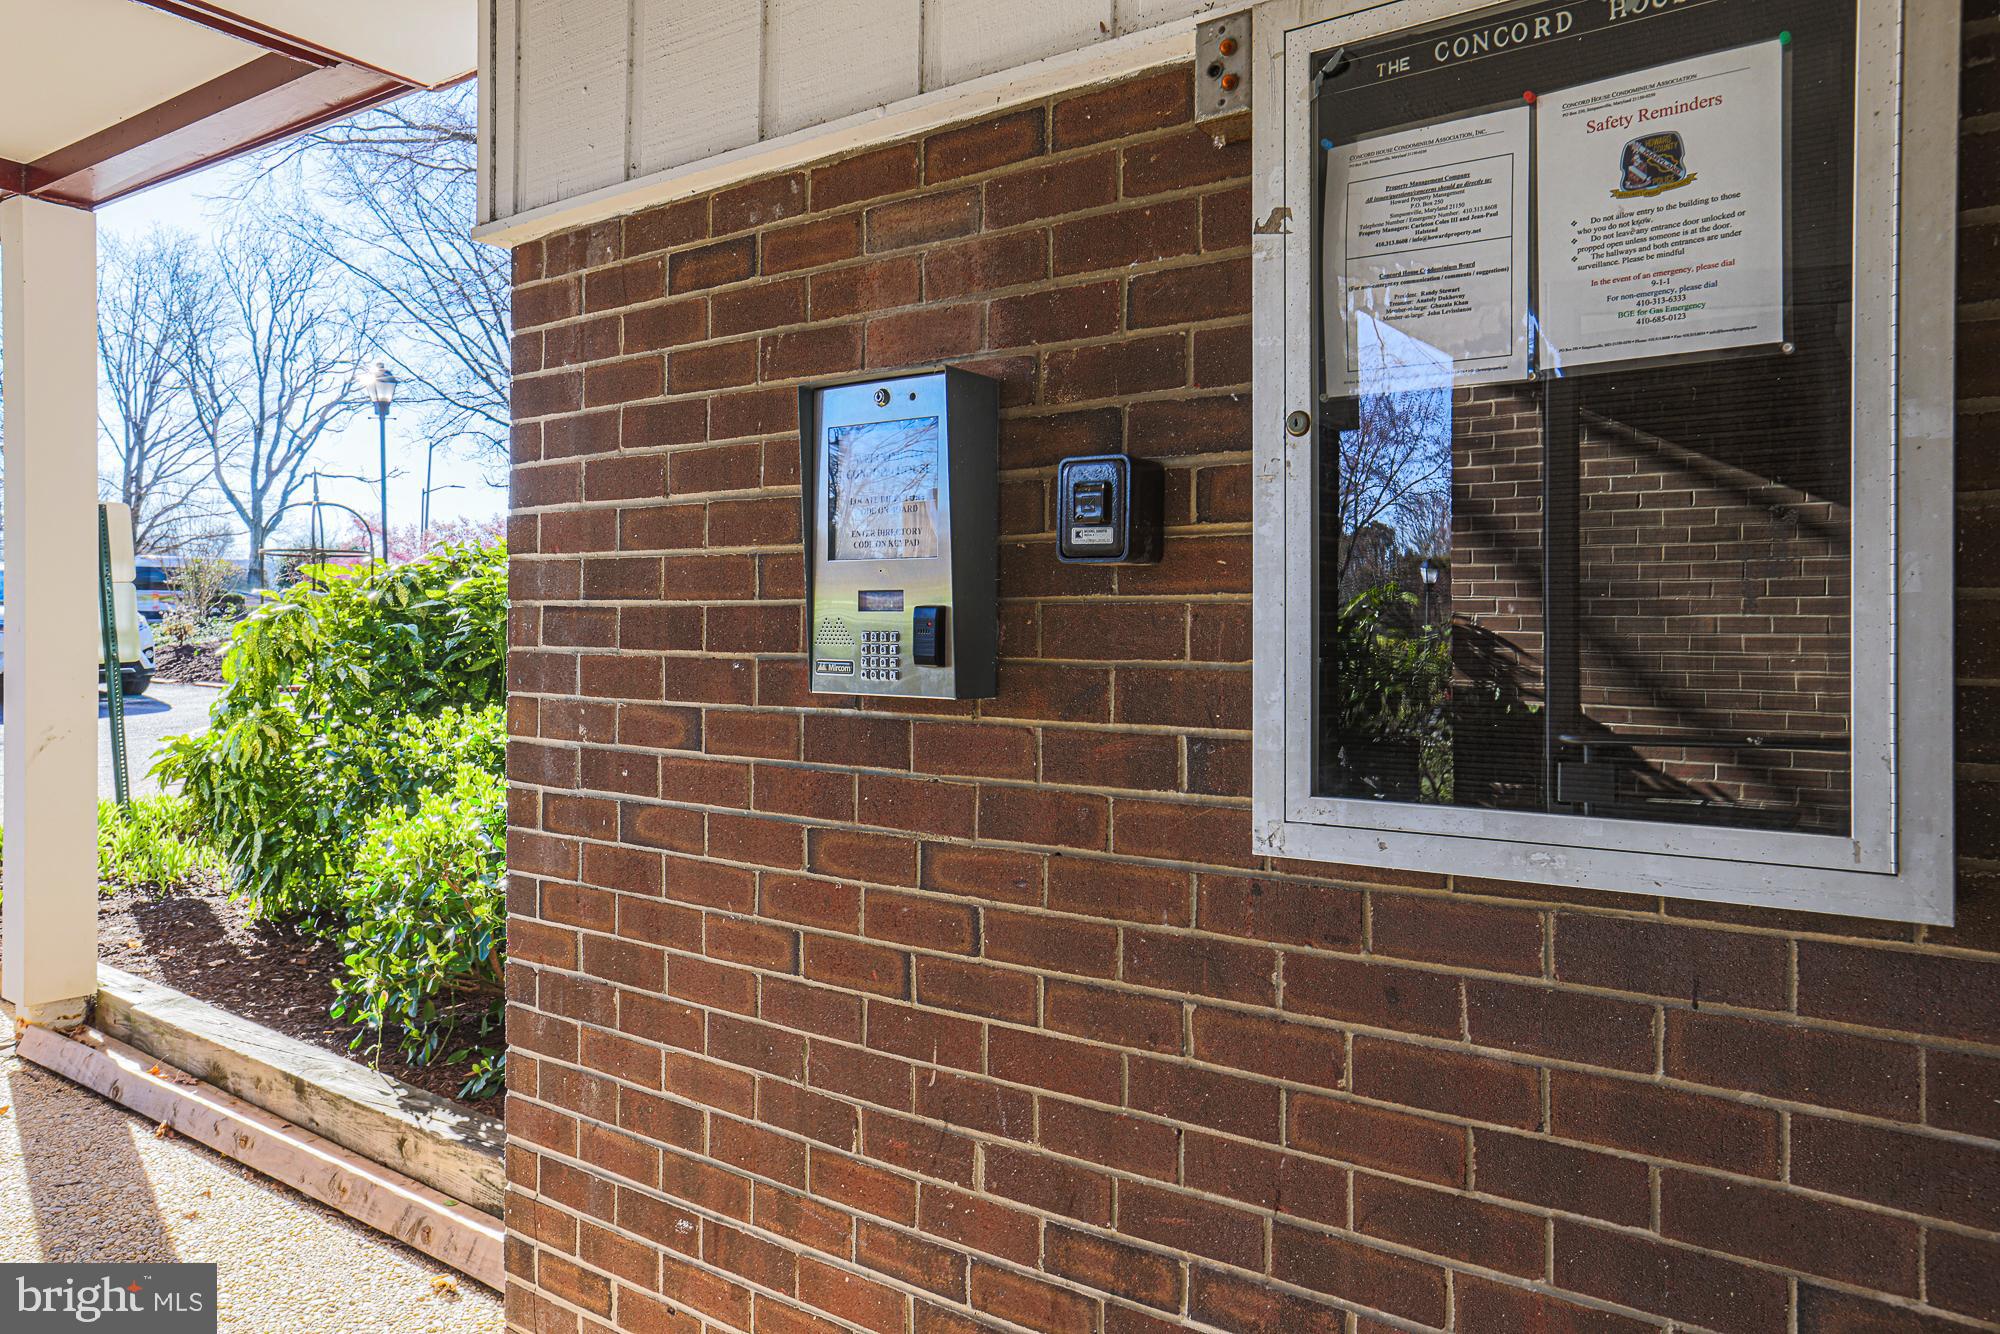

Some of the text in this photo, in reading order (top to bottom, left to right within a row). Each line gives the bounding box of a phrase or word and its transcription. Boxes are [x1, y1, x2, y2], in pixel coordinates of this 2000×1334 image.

[1376, 57, 1410, 78] THE
[1434, 10, 1574, 62] CONCORD
[1562, 98, 1589, 109] CONCORD
[1591, 93, 1610, 102] HOUSE
[1611, 82, 1654, 98] CONDOMINIUM
[1656, 72, 1696, 87] ASSOCIATION
[1586, 110, 1632, 137] Safety
[1638, 90, 1722, 122] Reminders
[1349, 150, 1374, 160] CONCORD
[1393, 138, 1434, 151] CONDOMINIUM
[1385, 171, 1470, 192] Property Management Company
[1438, 182, 1455, 191] should
[1464, 178, 1483, 187] directly
[1410, 194, 1431, 203] Property
[1432, 188, 1464, 199] Management
[1359, 221, 1383, 231] Telephone
[1385, 218, 1404, 226] Number
[1408, 212, 1436, 223] Emergency
[1462, 203, 1497, 214] 410.313.8608
[1424, 204, 1448, 213] Maryland
[1449, 201, 1464, 209] 21150
[1590, 216, 1600, 224] Do
[1615, 210, 1634, 219] allow
[1636, 206, 1654, 217] entry
[1665, 202, 1676, 210] the
[1678, 196, 1708, 209] building
[1720, 191, 1740, 200] those
[1358, 228, 1380, 238] Property
[1382, 224, 1409, 234] Managers:
[1410, 220, 1433, 229] Carleton
[1434, 217, 1449, 225] Coles
[1470, 209, 1498, 219] Jean-Paul
[1414, 226, 1437, 235] Halstead
[1577, 227, 1591, 235] who
[1618, 220, 1629, 228] not
[1631, 216, 1653, 225] know.
[1615, 228, 1634, 237] leave
[1636, 227, 1647, 235] any
[1650, 220, 1680, 231] entrance
[1682, 217, 1699, 226] door
[1701, 210, 1735, 222] unlocked
[1412, 227, 1481, 243] info@howardproperty.net
[1577, 243, 1604, 254] propped
[1606, 241, 1623, 249] open
[1625, 235, 1646, 245] unless
[1648, 231, 1680, 241] someone
[1699, 224, 1710, 232] the
[1712, 221, 1731, 230] door.
[1591, 252, 1604, 260] The
[1606, 246, 1636, 258] hallways
[1638, 244, 1650, 252] and
[1653, 241, 1668, 249] both
[1670, 236, 1704, 246] entrances
[1720, 229, 1742, 238] under
[1577, 258, 1620, 271] surveillance.
[1622, 254, 1644, 264] Please
[1656, 248, 1684, 258] mindful
[1379, 271, 1400, 280] Concord
[1403, 268, 1417, 276] House
[1459, 260, 1475, 269] Board
[1400, 274, 1440, 285] communication
[1444, 270, 1471, 279] comments
[1476, 265, 1509, 276] suggestions)
[1612, 274, 1631, 283] event
[1652, 266, 1693, 278] emergency,
[1696, 261, 1718, 272] please
[1720, 258, 1735, 266] dial
[1606, 279, 1717, 302] For non-emergency, please dial
[1651, 277, 1670, 286] 9-1-1
[1416, 296, 1436, 304] Anatoly
[1420, 289, 1437, 297] Randy
[1636, 293, 1686, 307] 410-313-6333
[1618, 300, 1705, 318] BGE for Gas Emergency
[1636, 312, 1686, 325] 410-685-0123
